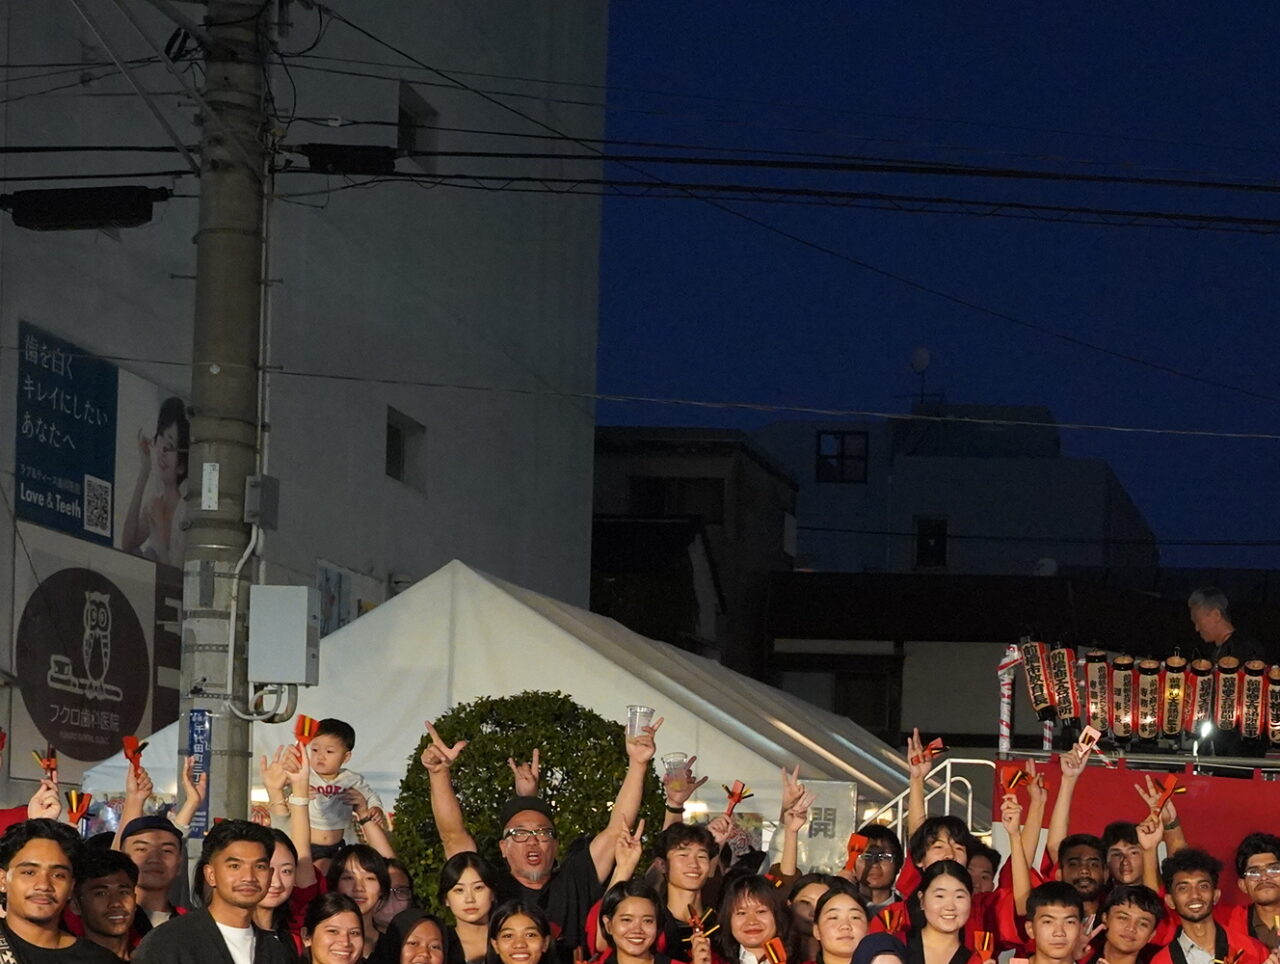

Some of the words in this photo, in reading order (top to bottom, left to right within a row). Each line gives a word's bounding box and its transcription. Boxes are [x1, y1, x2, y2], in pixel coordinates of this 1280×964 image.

[24, 334, 73, 380] 歯を白く
[23, 374, 108, 425] キレイにしたい
[21, 410, 76, 449] あなたへ
[20, 482, 44, 506] Love
[46, 492, 54, 509] &
[55, 494, 81, 518] Teeth
[49, 704, 120, 733] フクロ歯科医院
[192, 722, 207, 785] 千代田町三丁
[808, 807, 837, 839] 開
